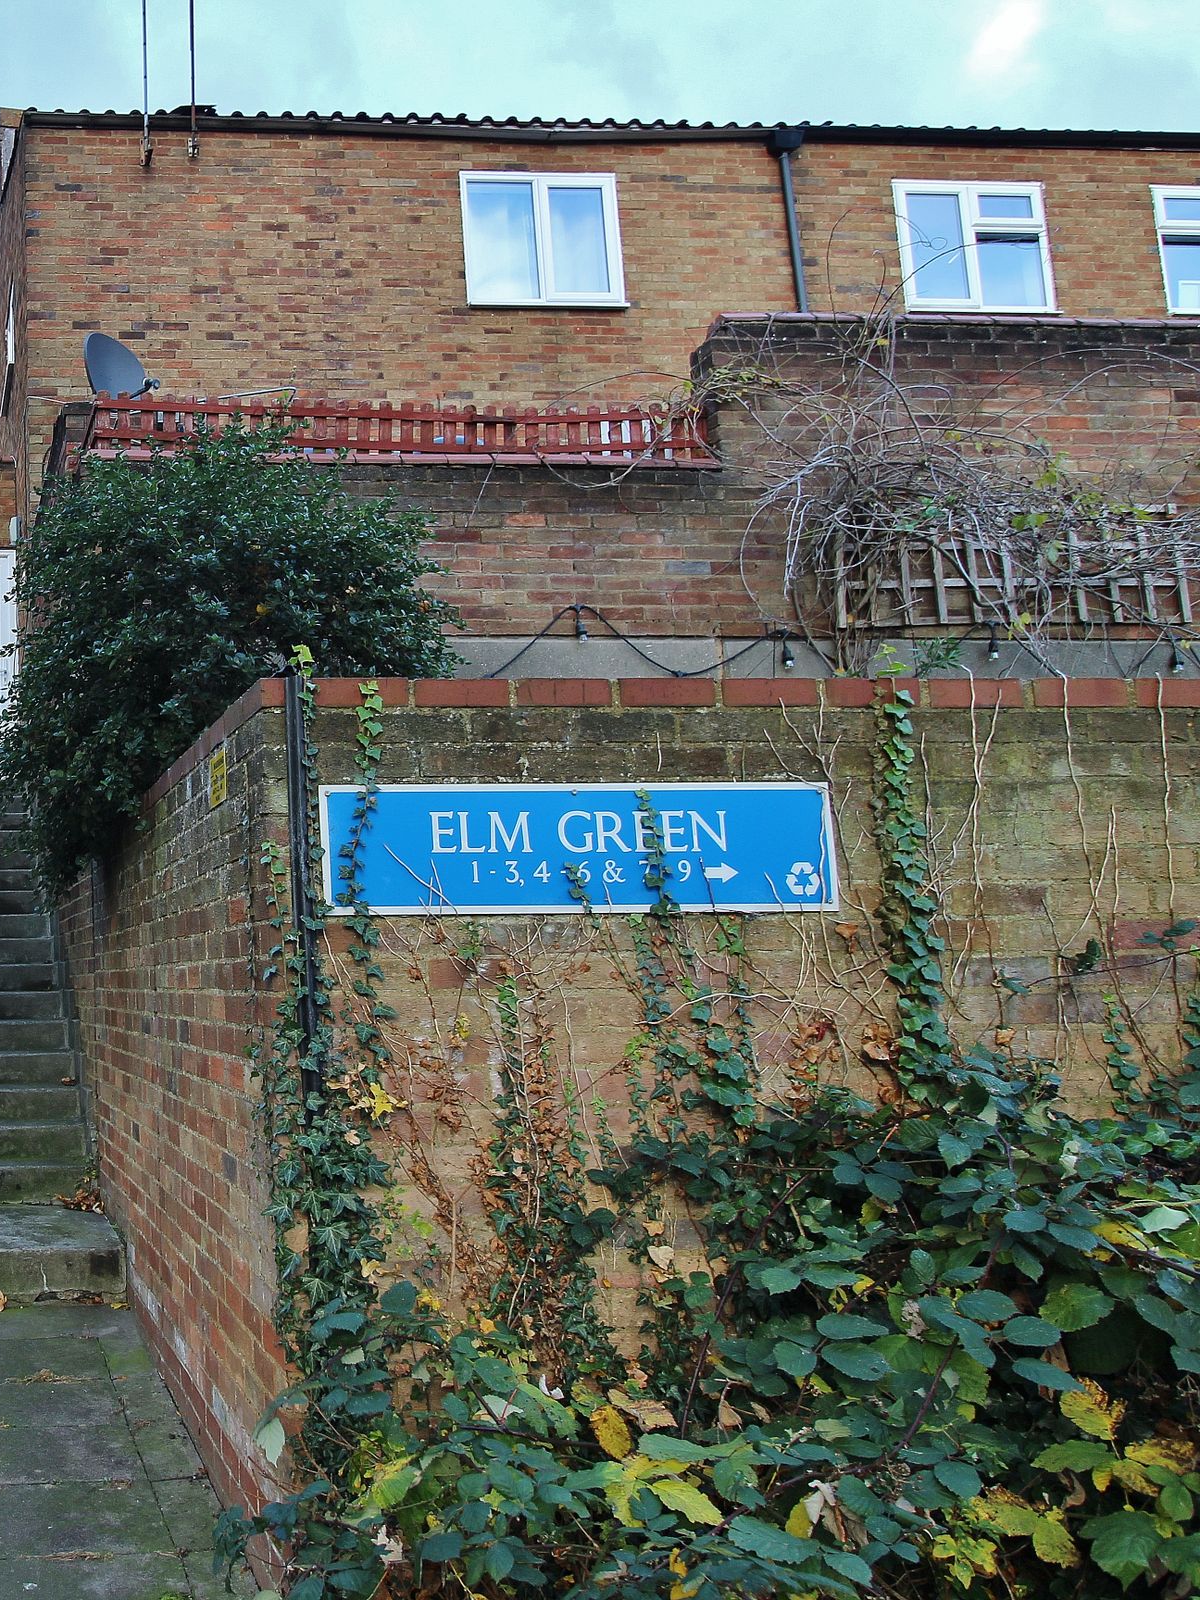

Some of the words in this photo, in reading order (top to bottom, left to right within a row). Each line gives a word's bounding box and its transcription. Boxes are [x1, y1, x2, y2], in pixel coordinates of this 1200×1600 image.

[428, 811, 534, 853] ELM
[557, 810, 727, 853] GREEN
[602, 860, 626, 883] &
